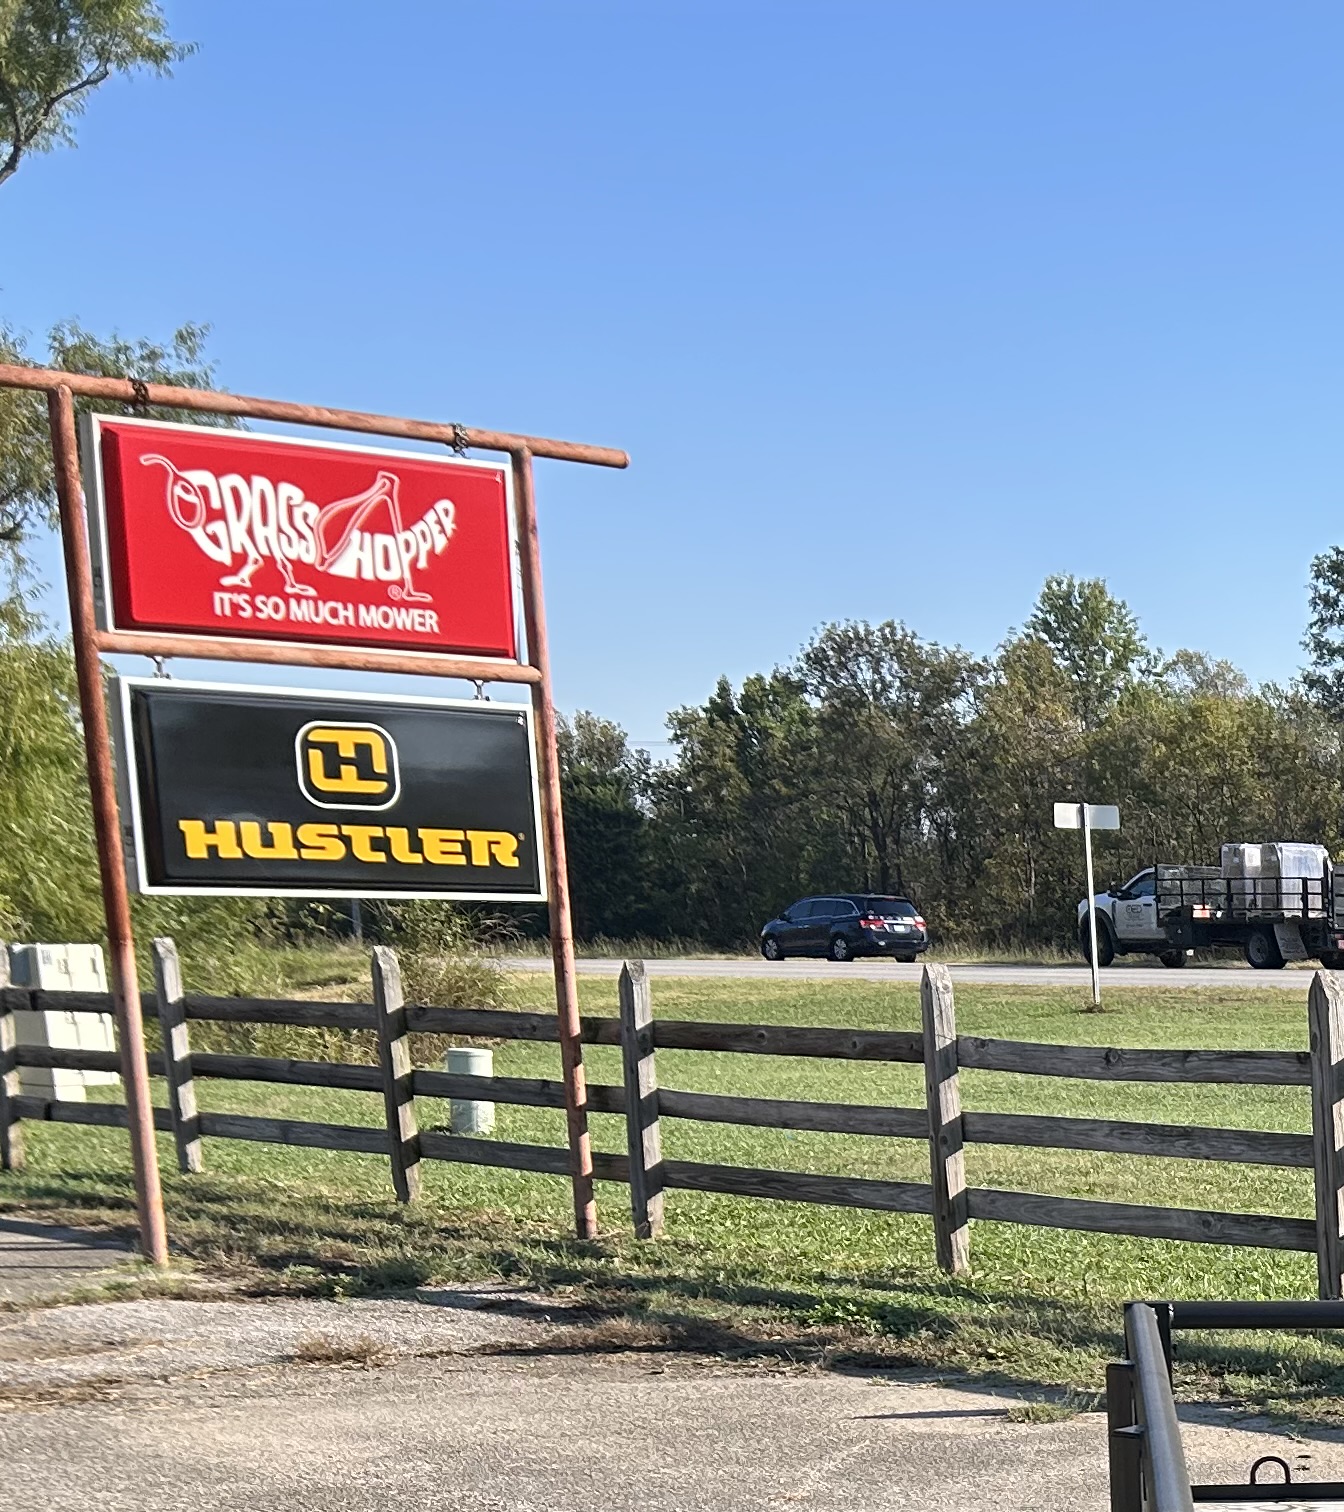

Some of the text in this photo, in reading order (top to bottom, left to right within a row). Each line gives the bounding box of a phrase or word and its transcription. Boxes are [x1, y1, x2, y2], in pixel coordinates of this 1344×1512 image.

[213, 591, 440, 633] IT'S SO MUCH MOWER
[178, 819, 519, 868] HUSTLER
